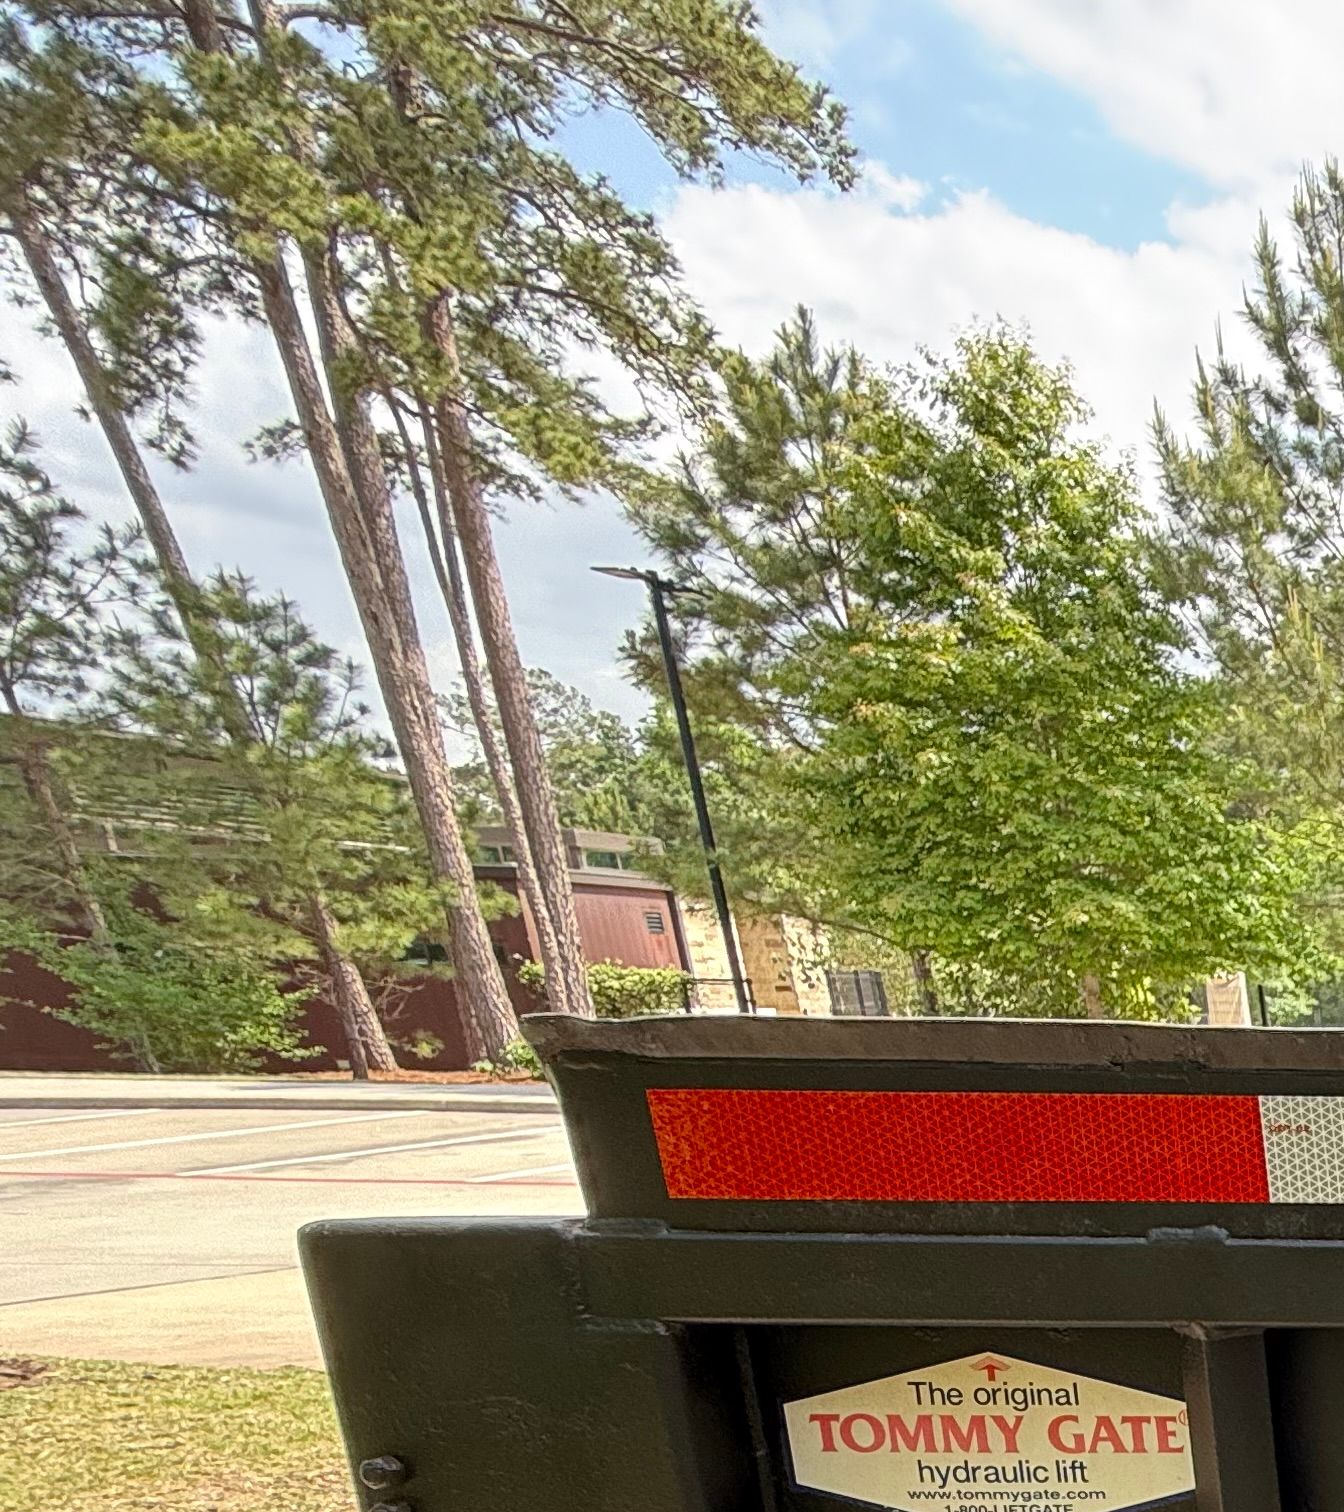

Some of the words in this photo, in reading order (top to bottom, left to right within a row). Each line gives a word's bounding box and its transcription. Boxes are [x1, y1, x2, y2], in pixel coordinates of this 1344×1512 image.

[907, 1381, 964, 1406] The
[973, 1382, 1080, 1412] original
[808, 1413, 1025, 1454] TOMMY
[917, 1459, 1050, 1489] hydraulic
[1055, 1459, 1090, 1484] lift
[907, 1489, 1107, 1502] www.tommygate.com
